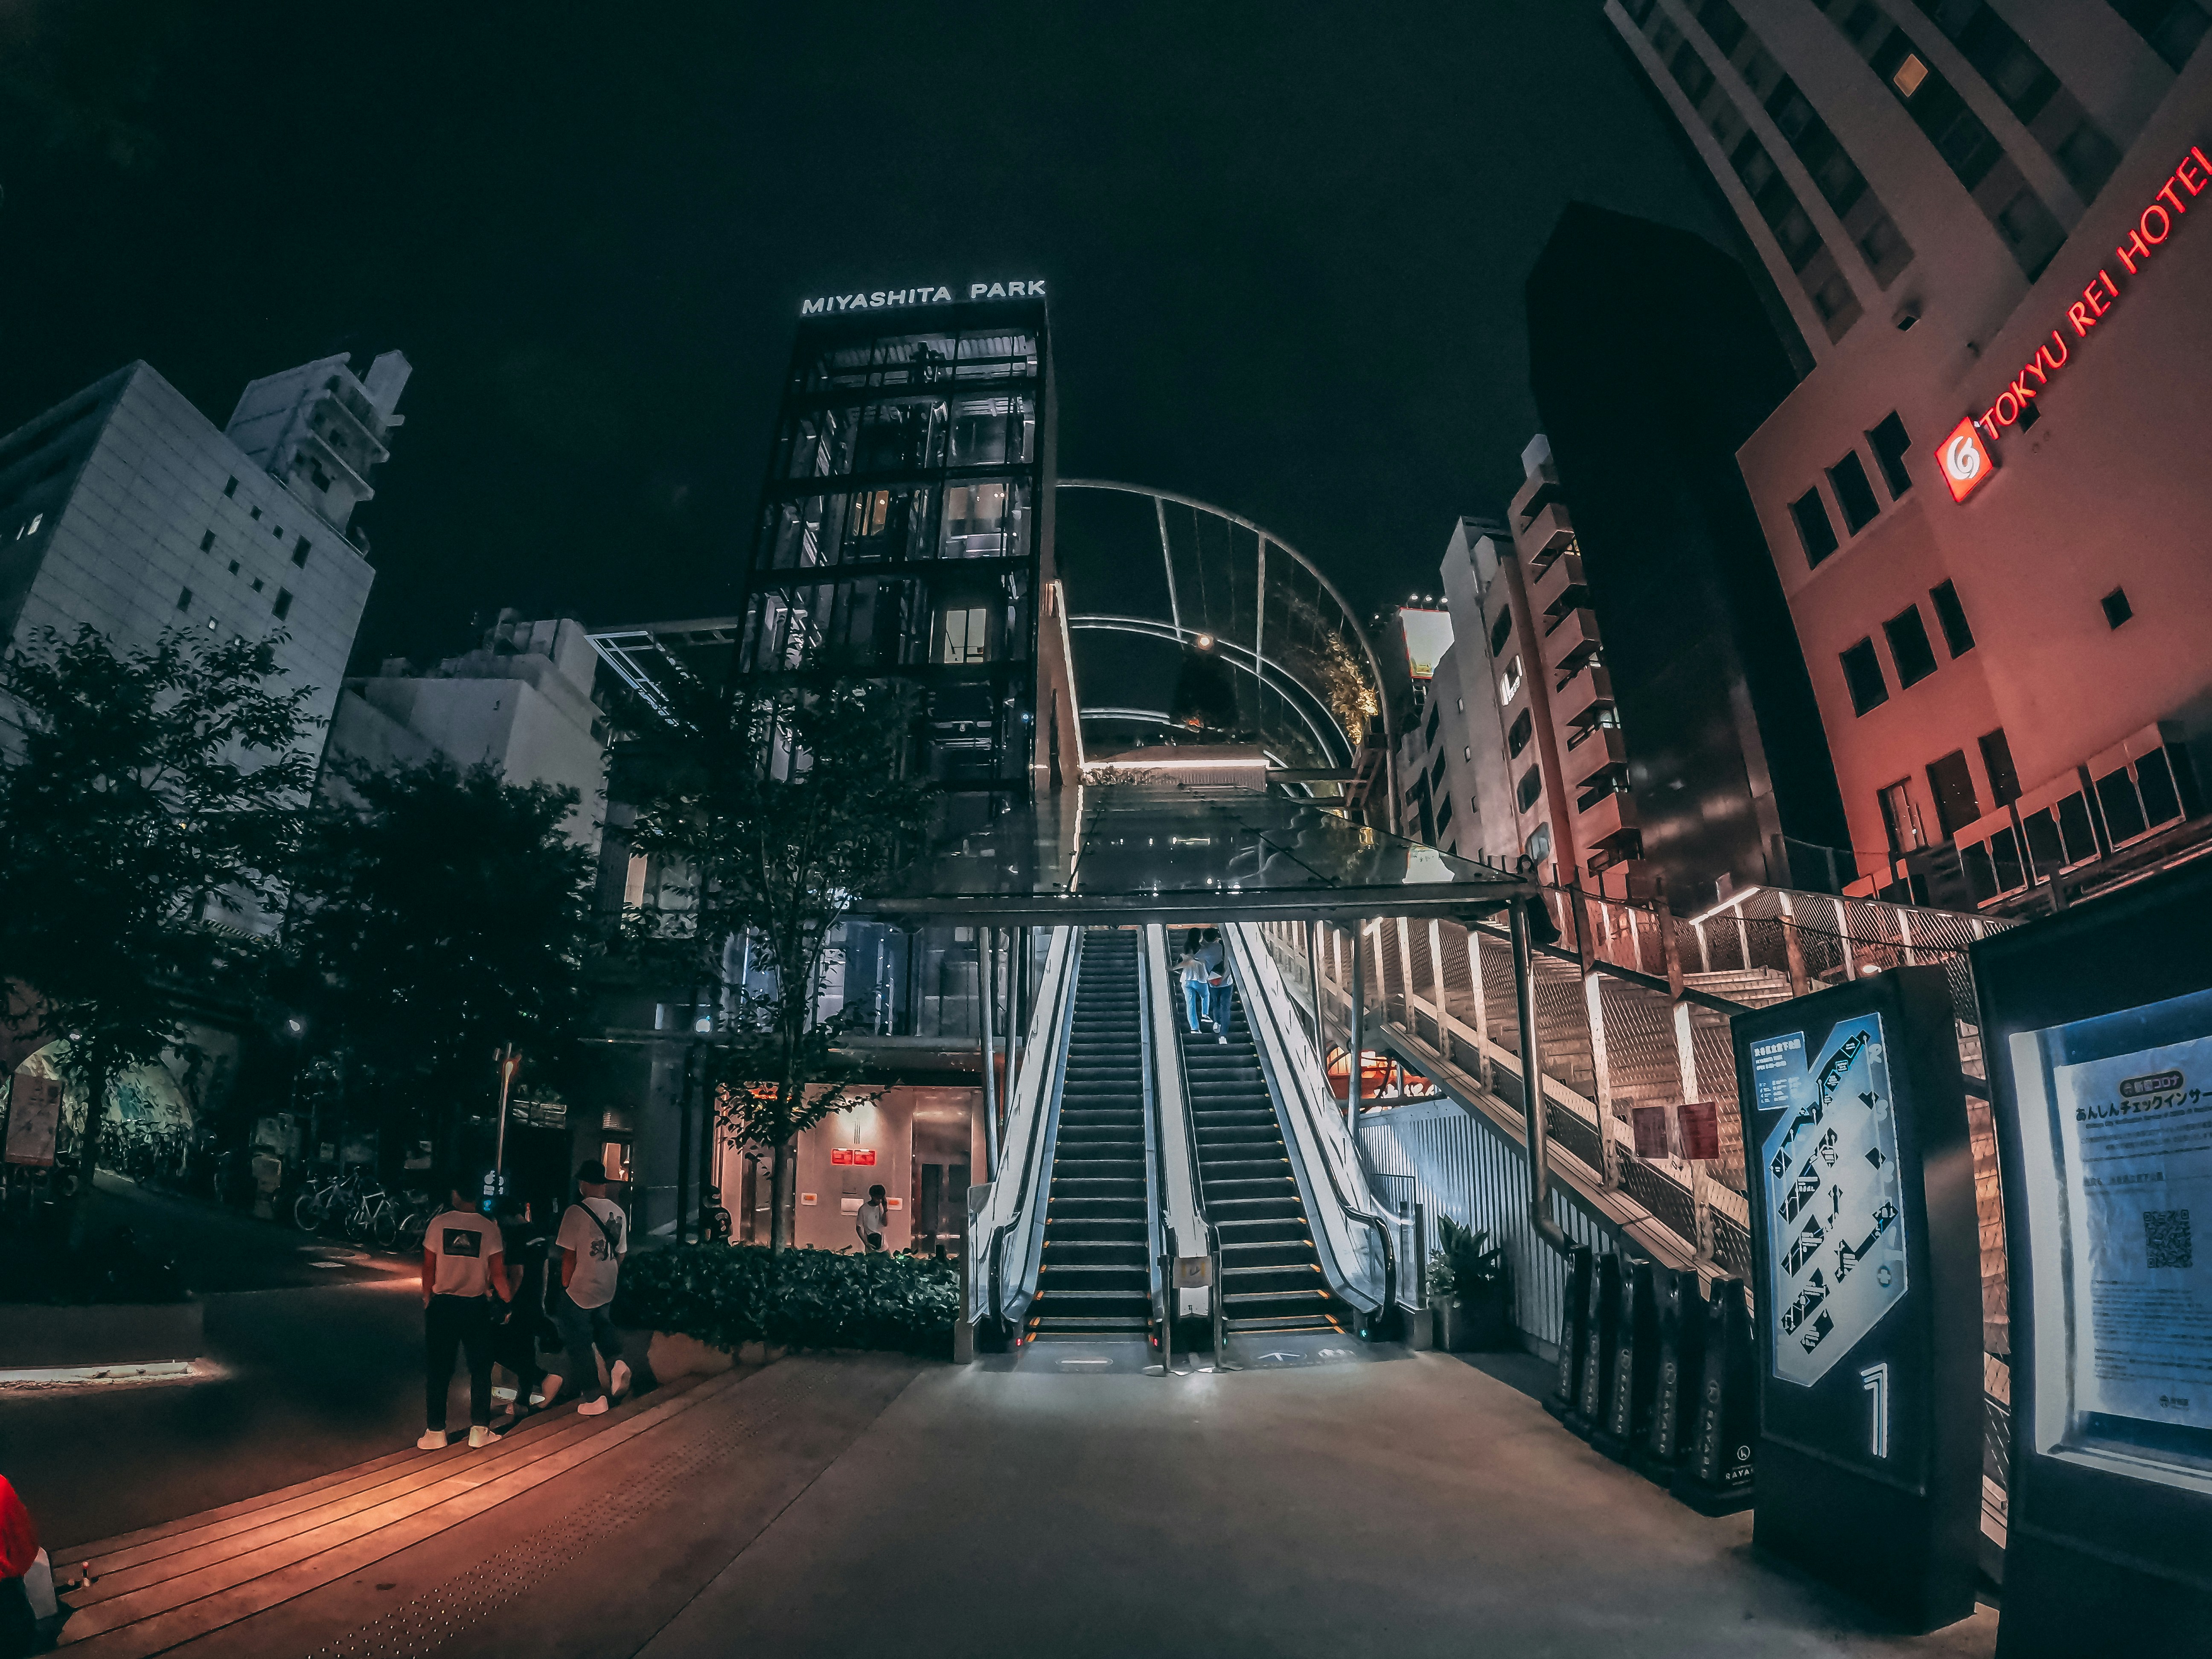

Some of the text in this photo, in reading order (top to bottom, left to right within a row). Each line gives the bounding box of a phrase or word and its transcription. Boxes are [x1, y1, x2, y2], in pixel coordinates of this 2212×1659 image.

[801, 279, 1047, 314] MIYASHITA PARK
[1979, 330, 2068, 440] TOKYU
[2066, 269, 2119, 338] REI
[2133, 1074, 2180, 1093] コロナ
[1860, 1362, 1888, 1459] 1
[1725, 1467, 1754, 1480] RAYA
